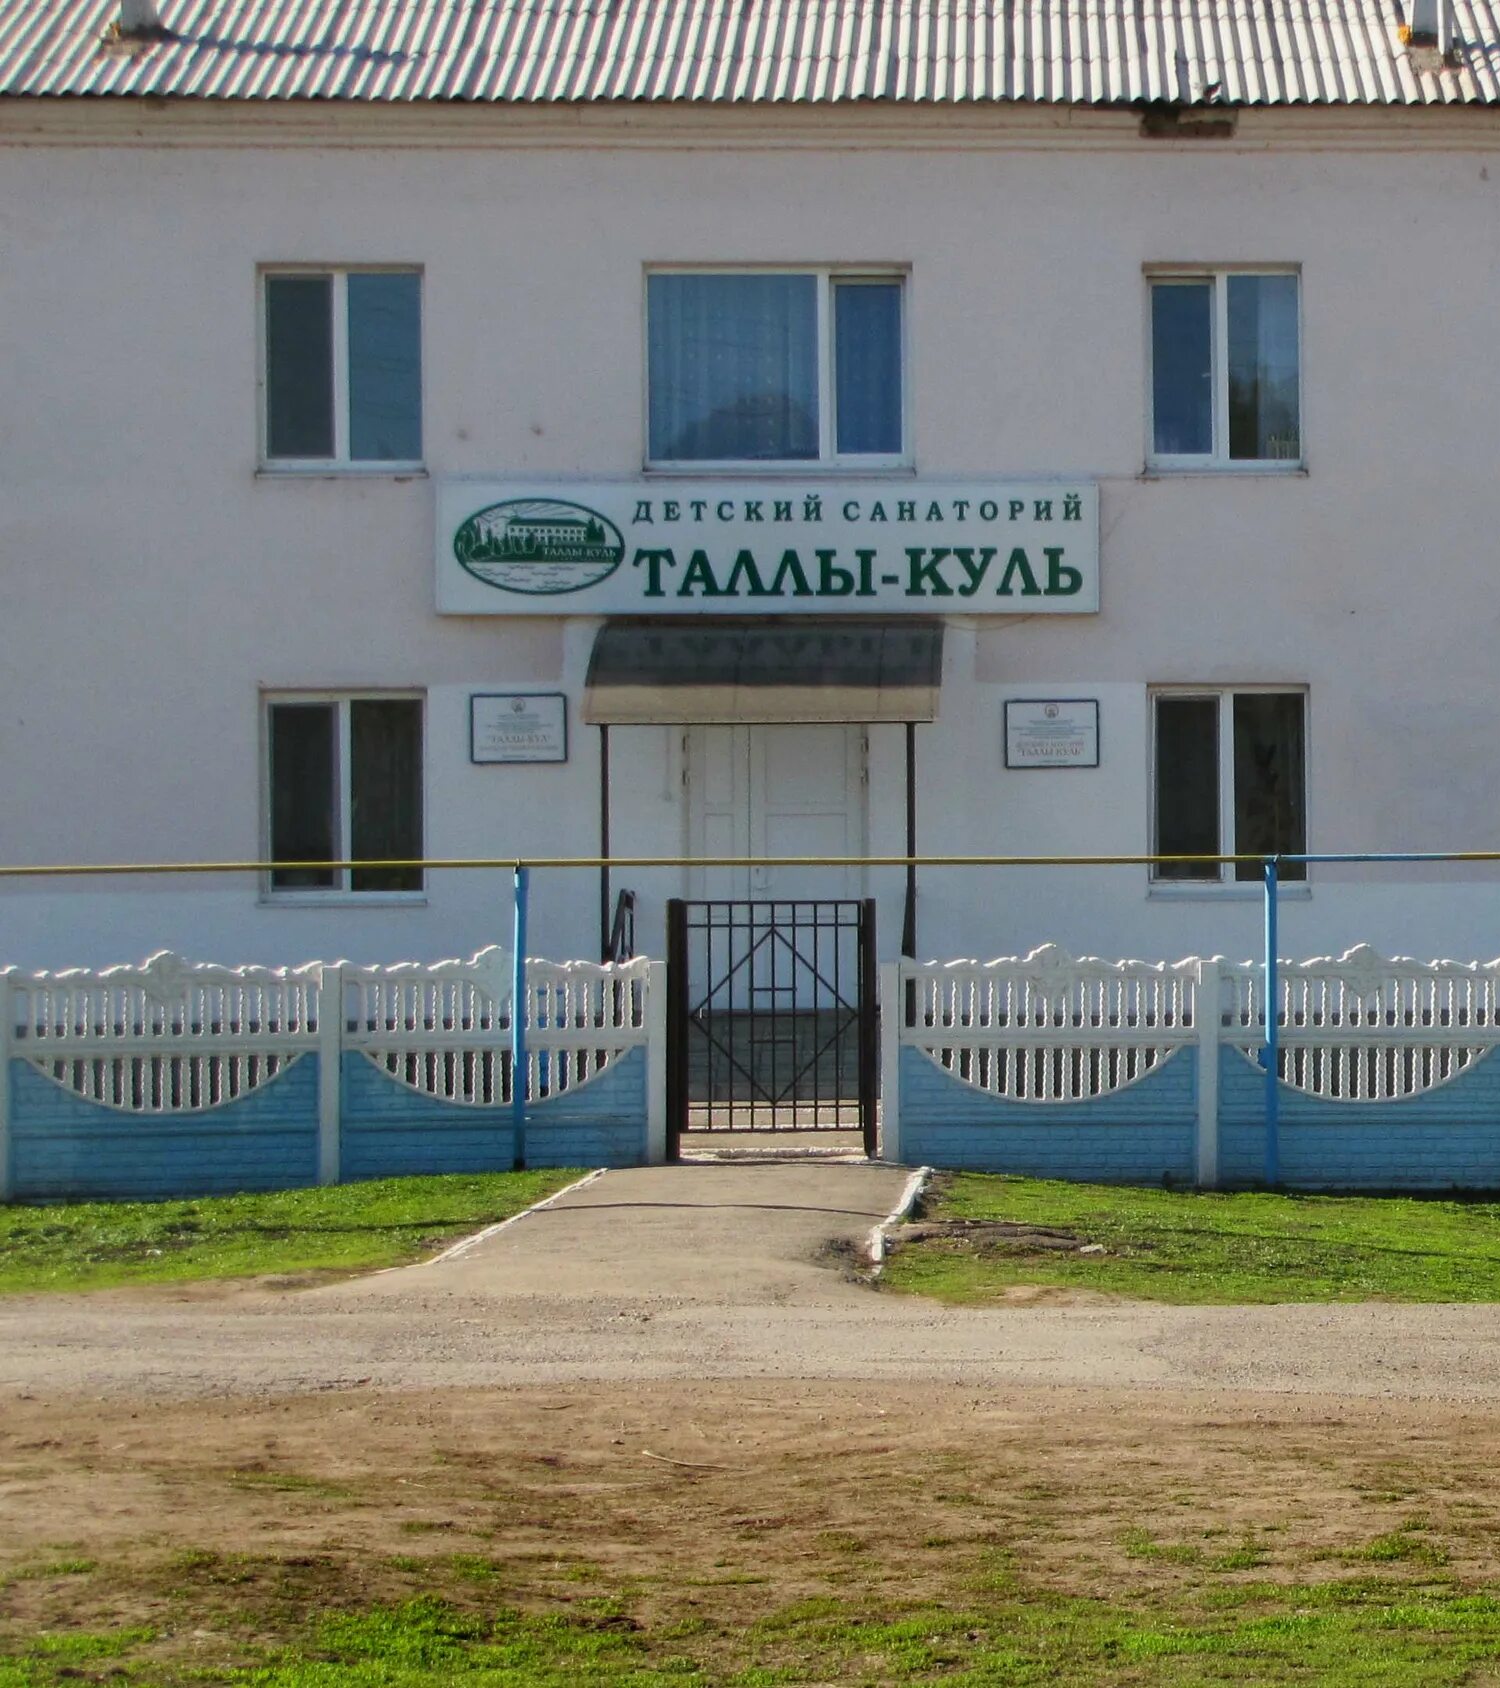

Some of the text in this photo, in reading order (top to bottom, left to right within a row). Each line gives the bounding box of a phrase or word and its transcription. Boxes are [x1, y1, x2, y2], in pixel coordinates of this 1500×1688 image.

[631, 492, 1082, 526] ДЕТСКИЙ САНАТОРИЙ
[631, 546, 1083, 598] ТАЛЛЫ-КУЛЬ
